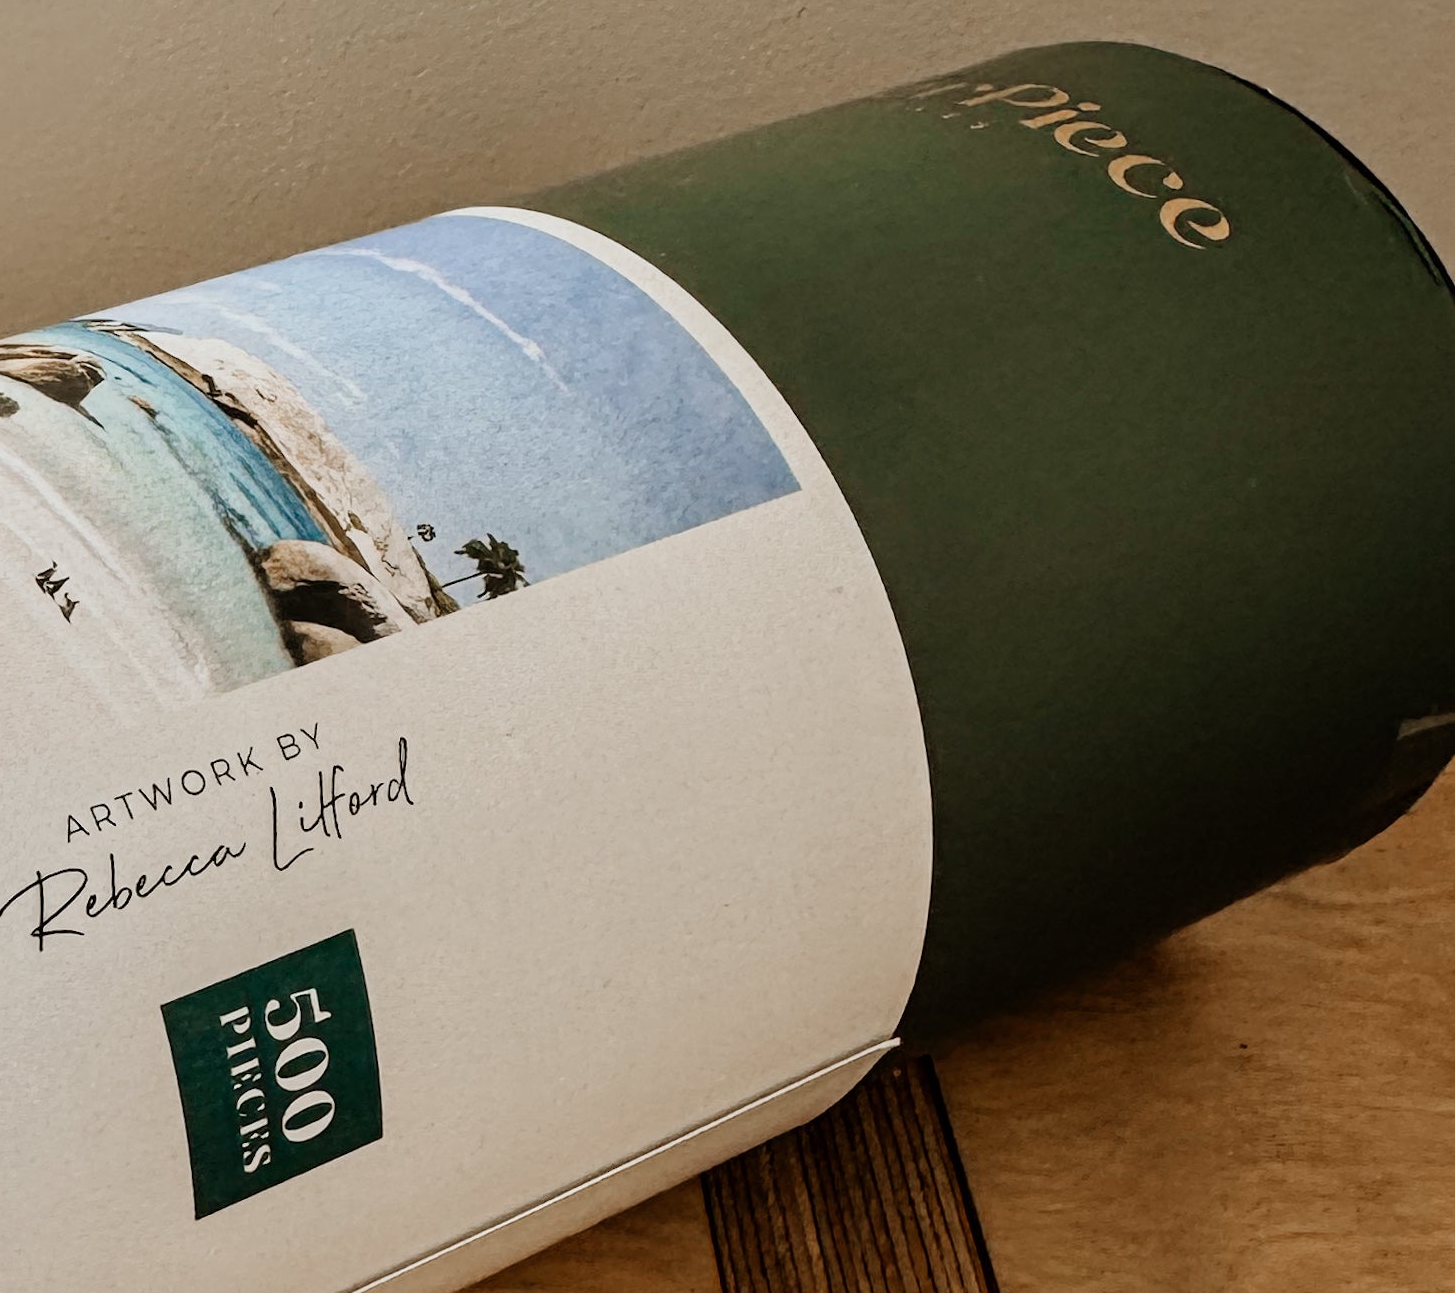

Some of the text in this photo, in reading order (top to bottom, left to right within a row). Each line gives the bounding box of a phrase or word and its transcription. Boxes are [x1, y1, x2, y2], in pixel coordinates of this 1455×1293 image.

[66, 722, 322, 843] ARTWORK BY
[220, 1006, 272, 1173] PIECES
[264, 987, 336, 1144] 500
